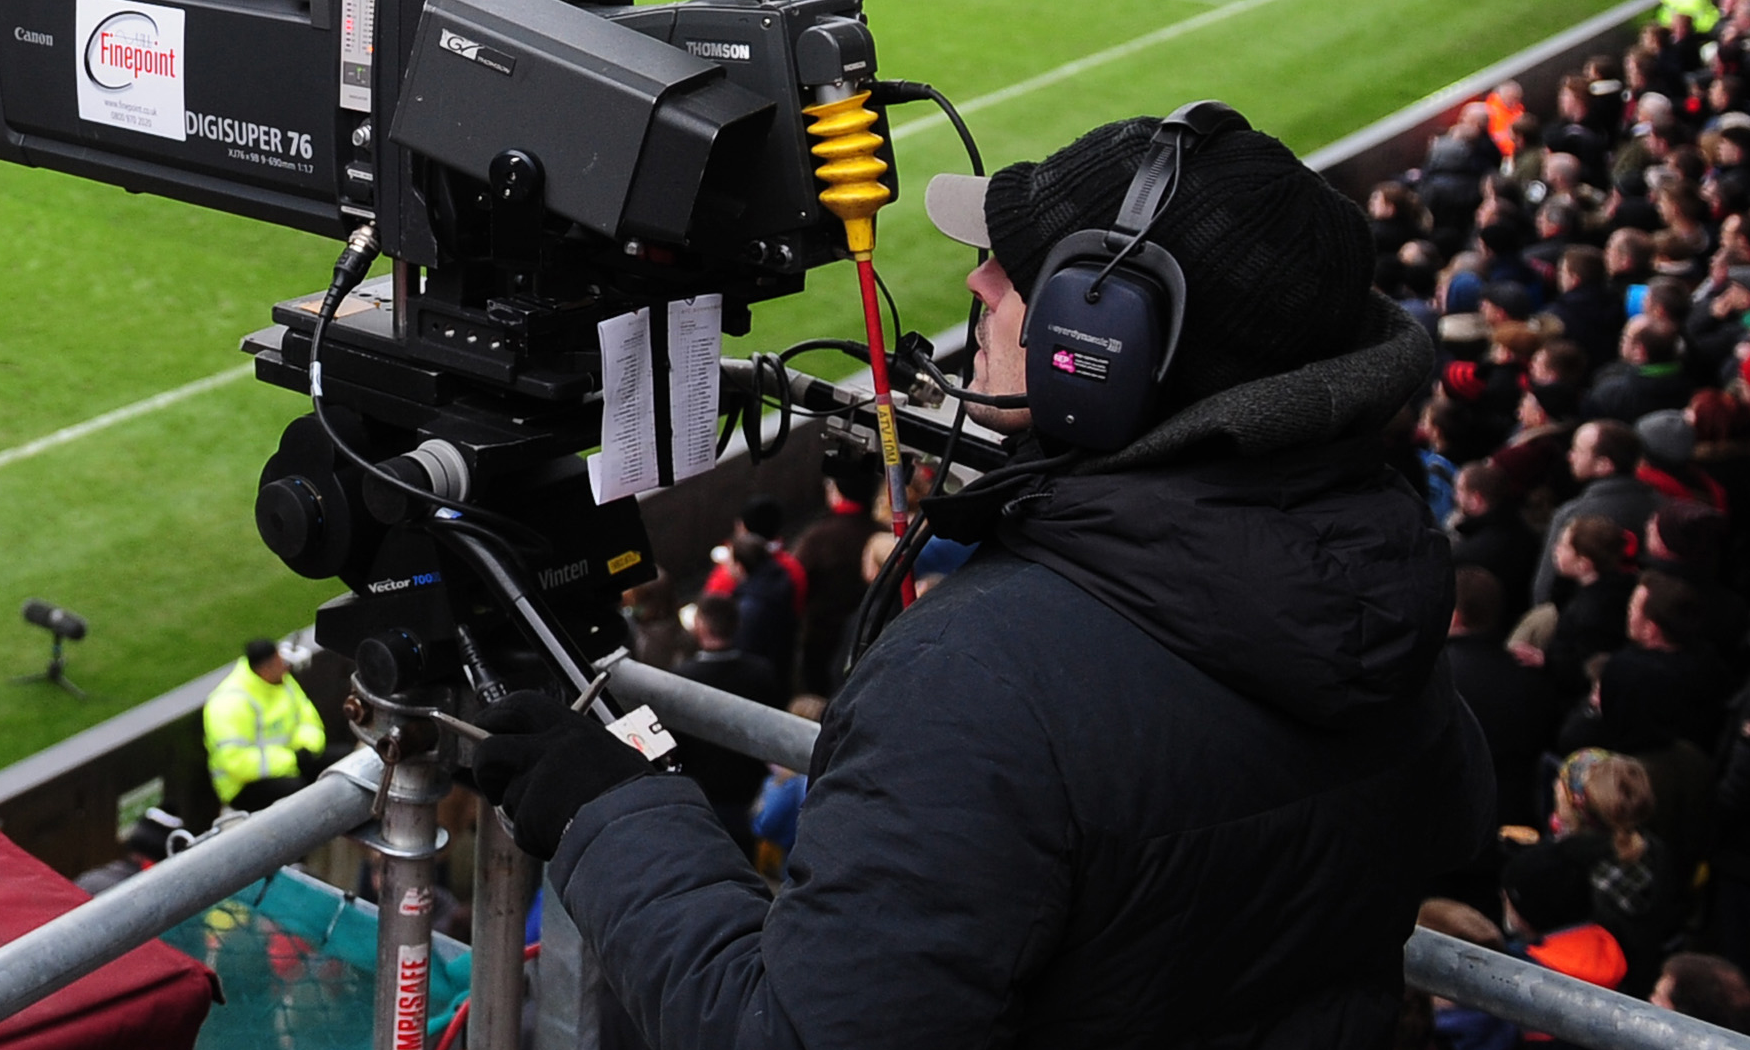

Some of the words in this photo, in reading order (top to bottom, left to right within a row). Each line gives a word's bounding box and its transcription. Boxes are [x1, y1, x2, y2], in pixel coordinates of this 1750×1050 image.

[14, 26, 54, 47] Canon
[101, 32, 176, 79] Finepoint
[686, 41, 750, 60] THOMSON
[186, 110, 283, 154] DIGISUPER
[287, 131, 313, 159] 76
[878, 411, 892, 436] ATV
[883, 438, 897, 463] 10M
[368, 578, 411, 593] Vector
[538, 559, 589, 590] Vinten
